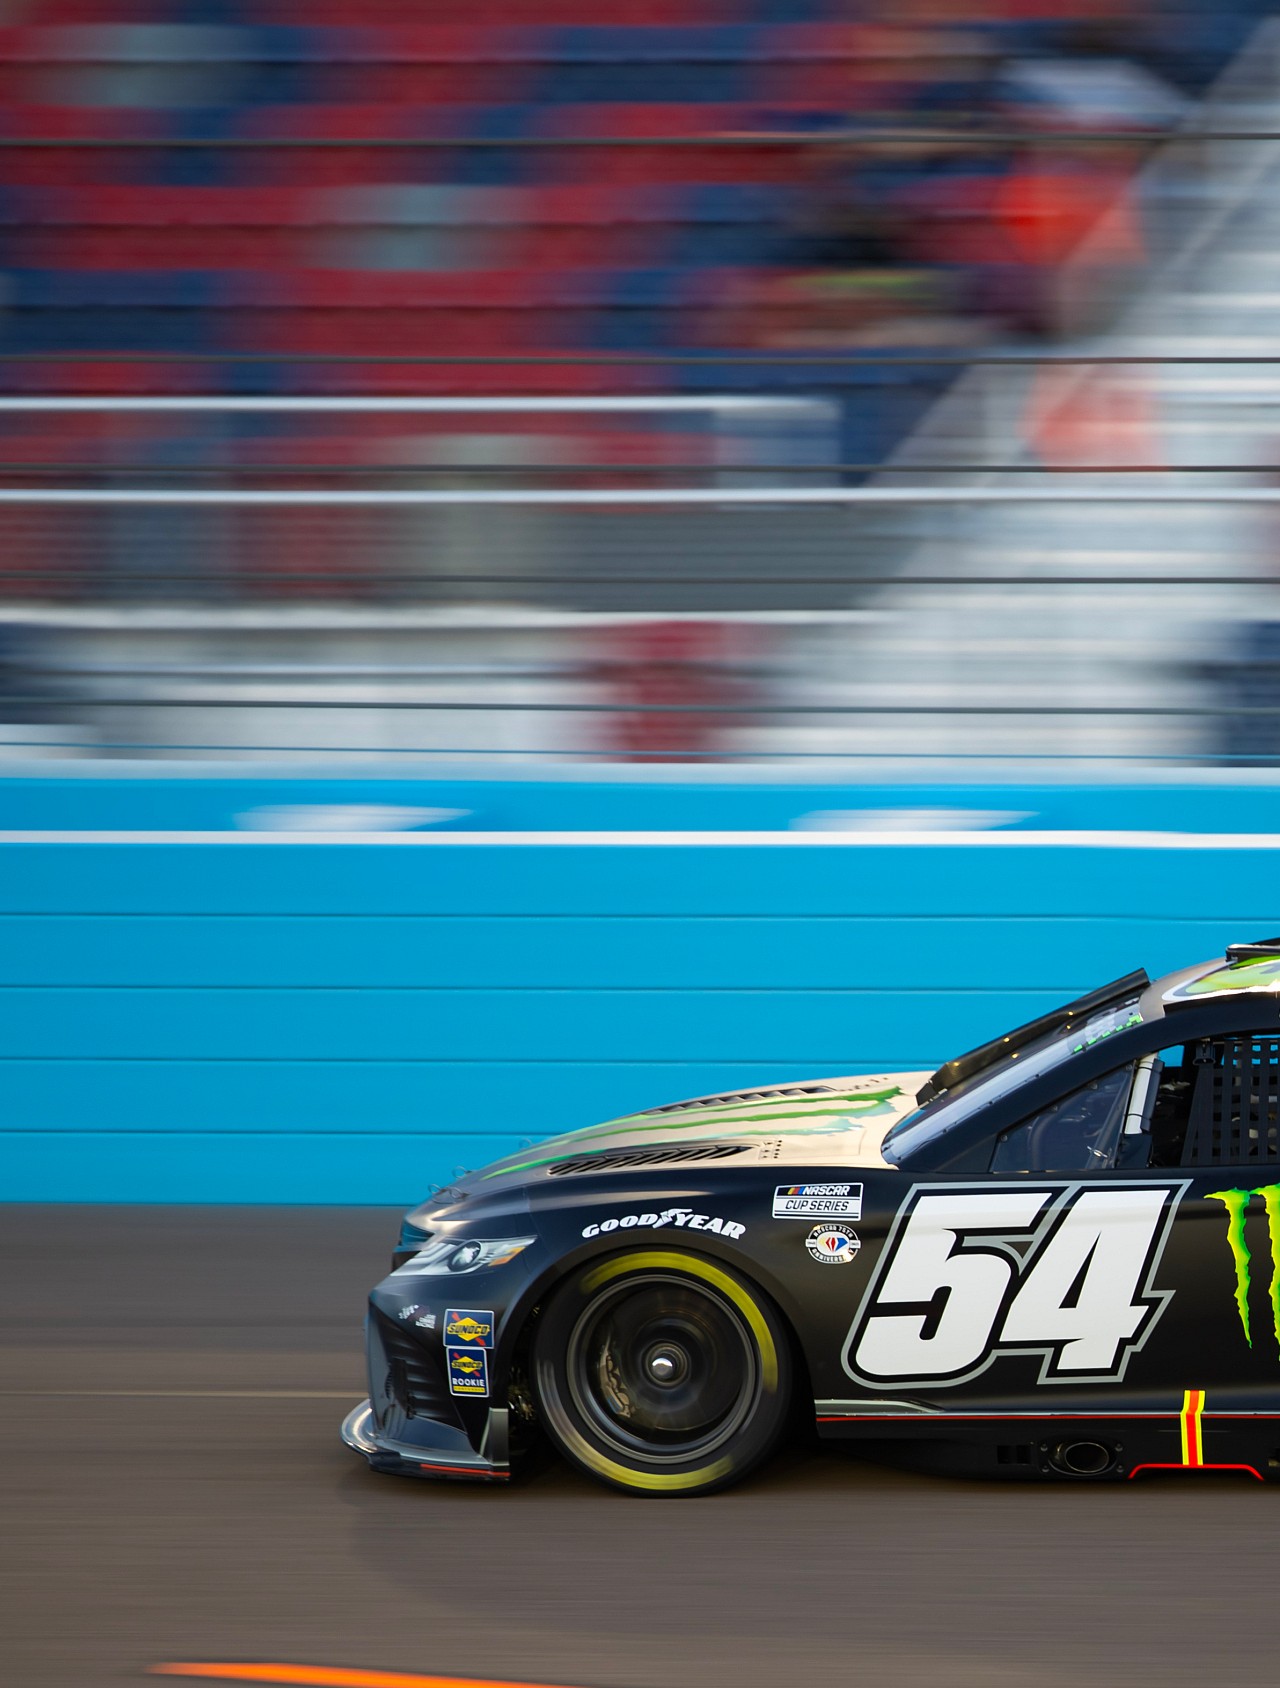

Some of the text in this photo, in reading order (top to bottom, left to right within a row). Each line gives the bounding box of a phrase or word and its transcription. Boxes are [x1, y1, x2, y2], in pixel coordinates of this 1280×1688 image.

[802, 1185, 851, 1196] NASCAR
[785, 1199, 849, 1212] CUP SERIES
[582, 1210, 746, 1239] GOODYEAR
[813, 1225, 837, 1237] NASCAR
[855, 1189, 1171, 1376] 54
[448, 1324, 489, 1335] SUNOCO
[452, 1378, 485, 1387] ROOKIE
